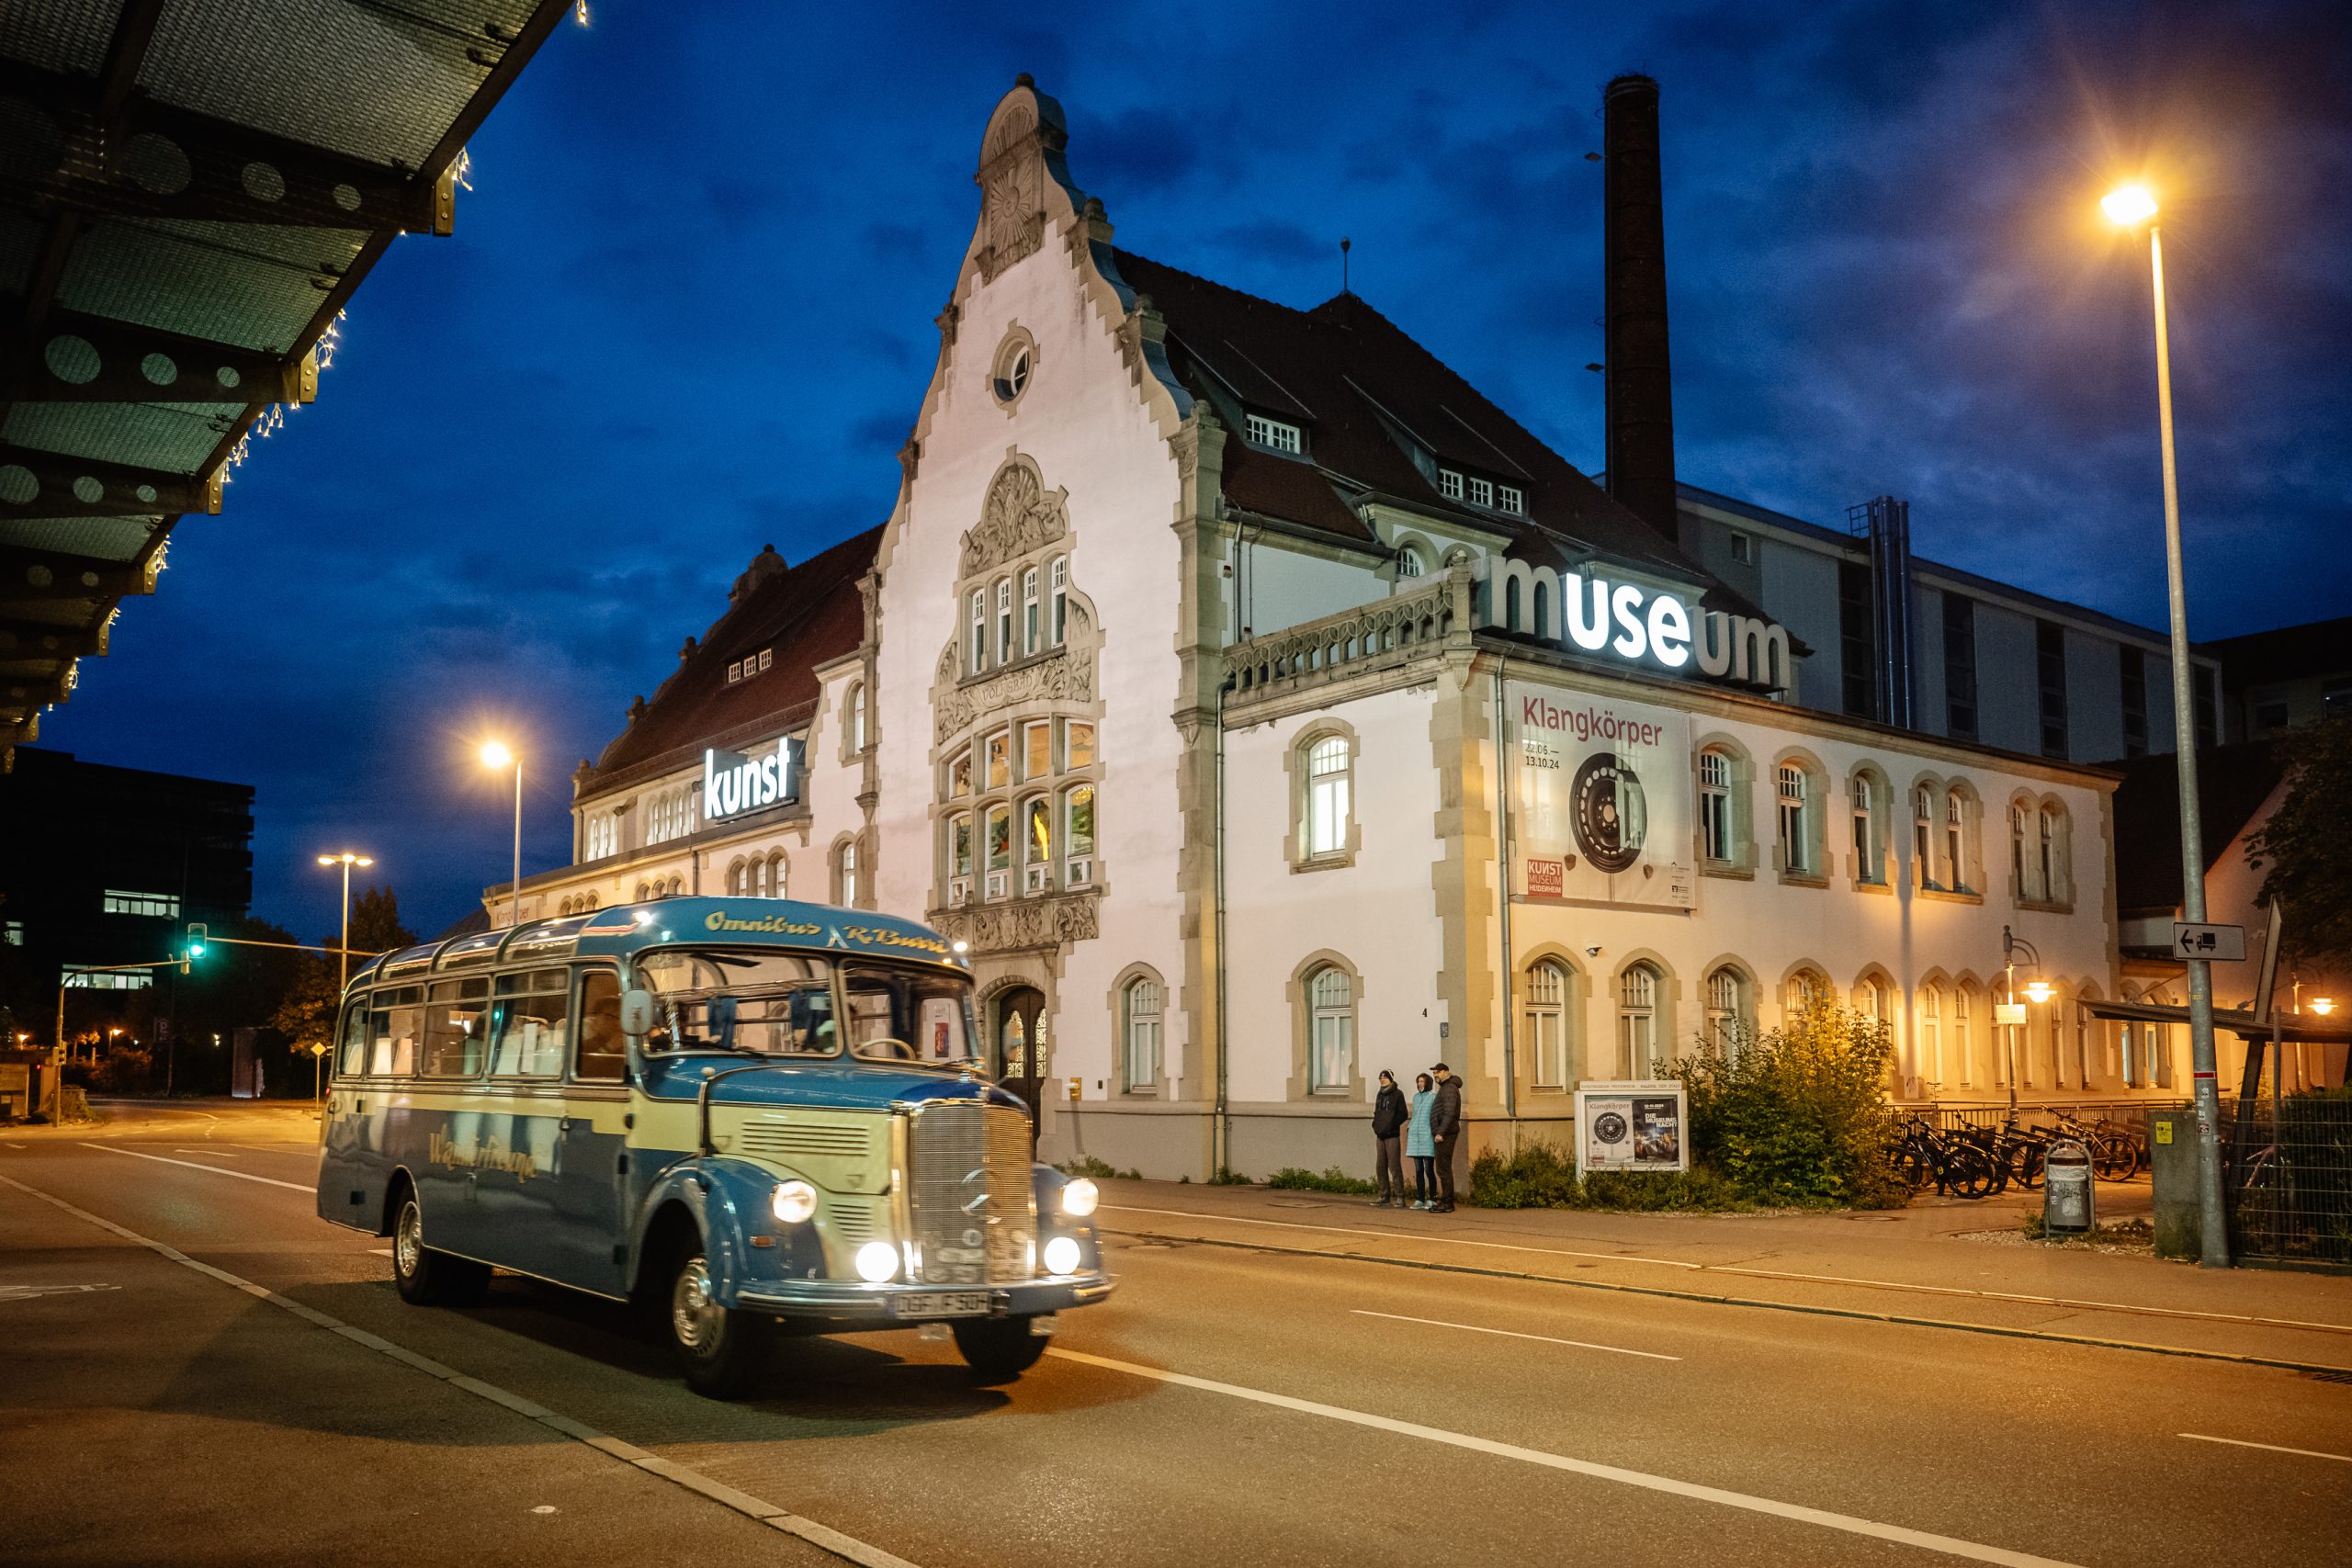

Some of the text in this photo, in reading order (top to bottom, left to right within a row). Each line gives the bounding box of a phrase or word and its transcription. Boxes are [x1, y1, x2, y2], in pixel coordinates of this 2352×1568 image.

[1490, 555, 1790, 689] museum
[1523, 696, 1662, 749] Klangkörper
[1525, 756, 1559, 769] 13.10.24
[705, 738, 790, 819] kunst
[1529, 874, 1561, 886] MUSEUM
[705, 911, 821, 935] Omnibus
[1422, 1008, 1427, 1017] 4
